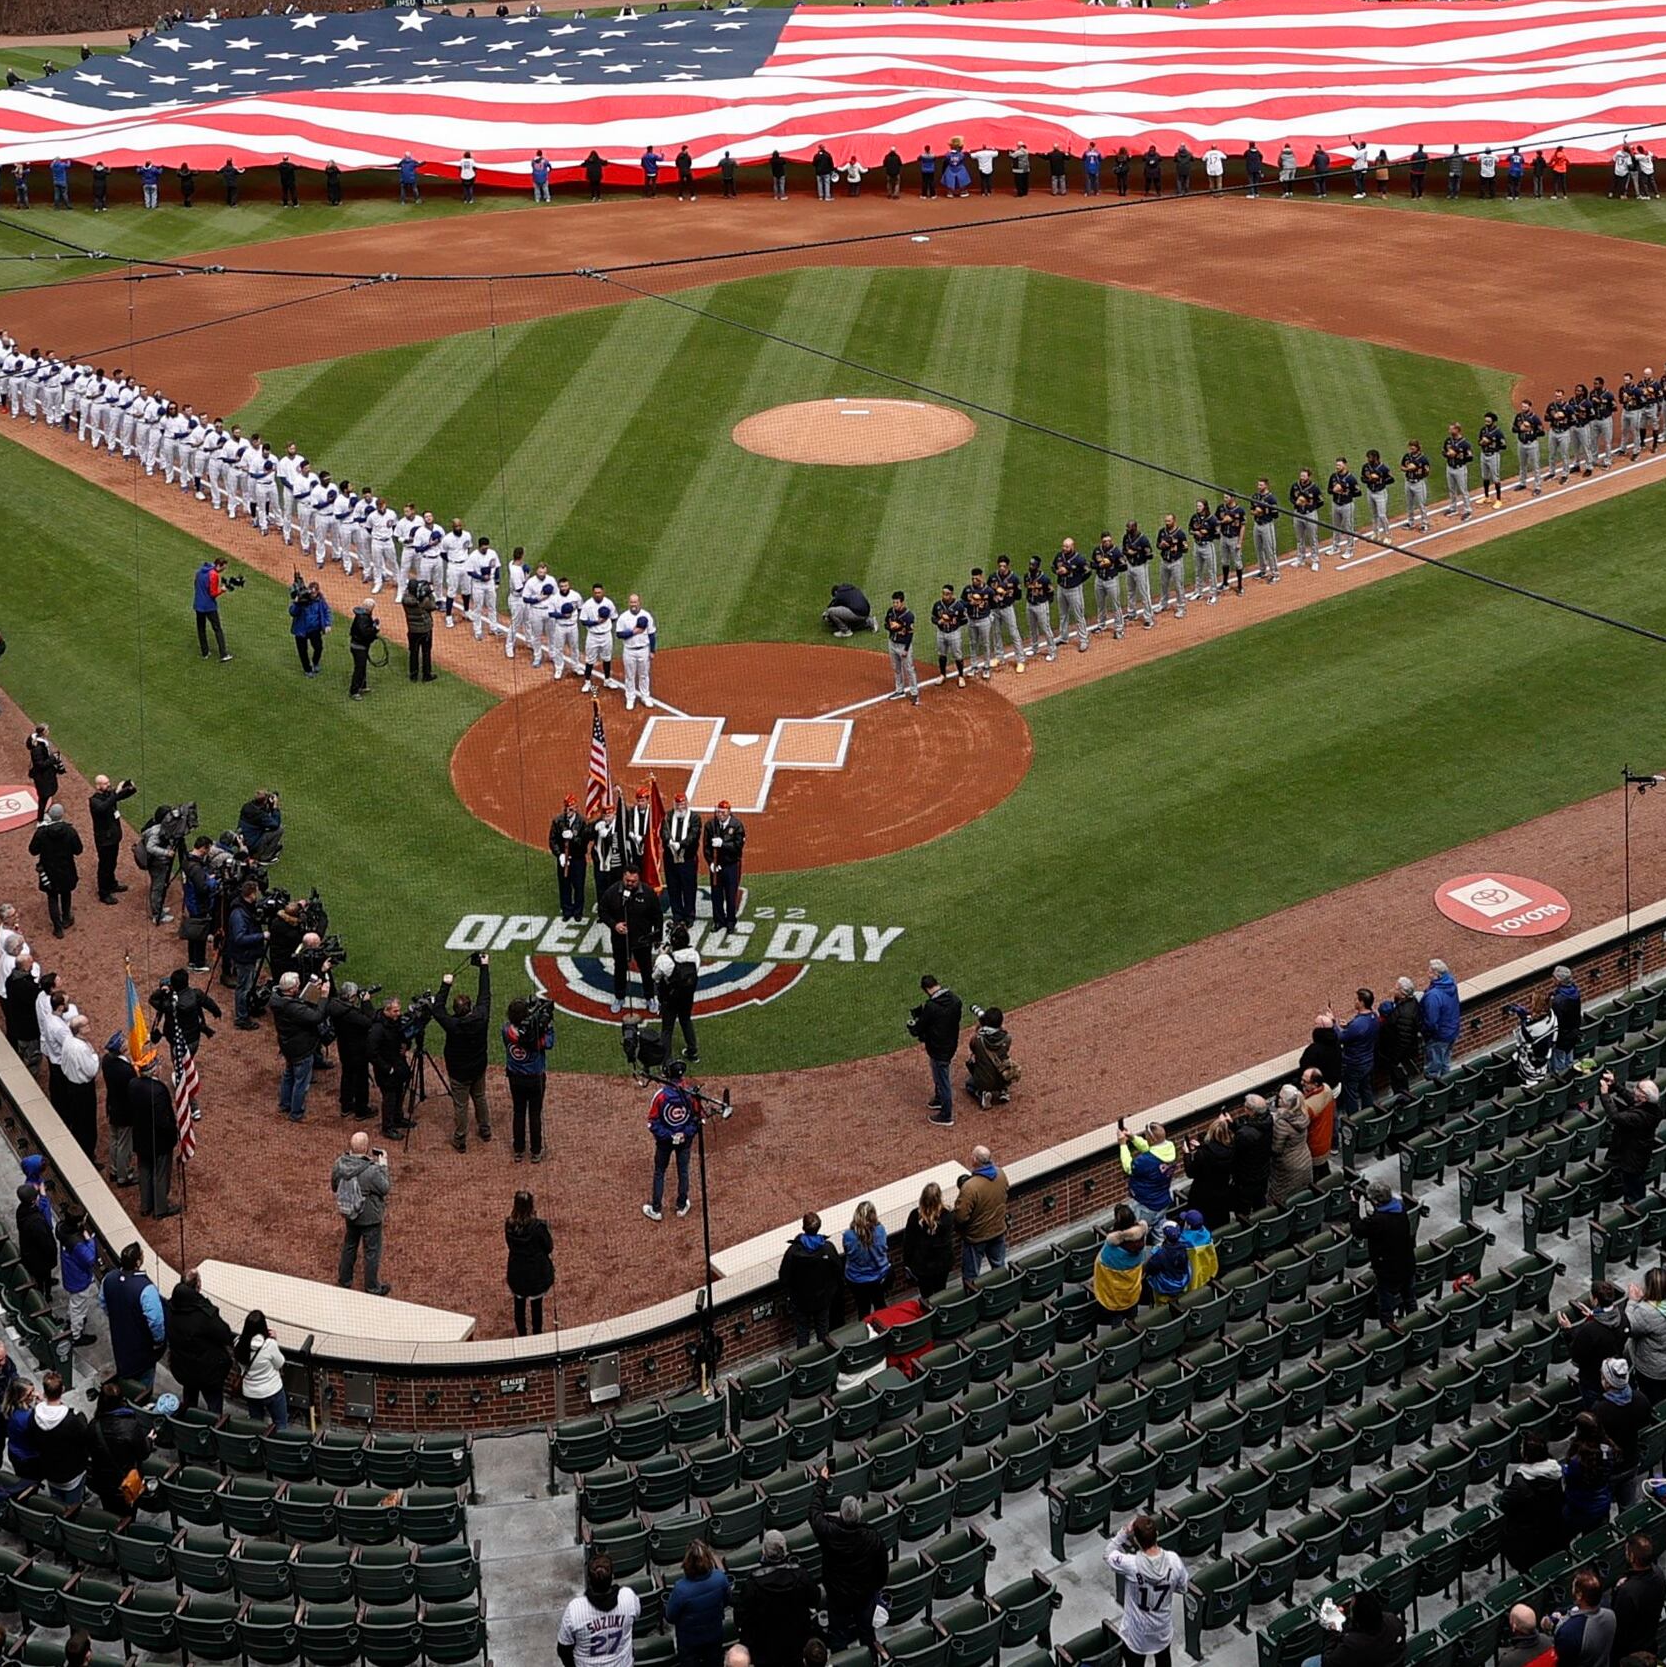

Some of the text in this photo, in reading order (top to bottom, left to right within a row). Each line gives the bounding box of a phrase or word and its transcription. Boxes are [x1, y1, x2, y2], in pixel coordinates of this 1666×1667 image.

[754, 907, 807, 920] 22
[1491, 903, 1566, 933] TOYOTA
[445, 914, 906, 962] OPENG DAY
[1138, 1584, 1171, 1612] 17
[587, 1615, 625, 1634] SUZUKI
[590, 1630, 623, 1657] 27
